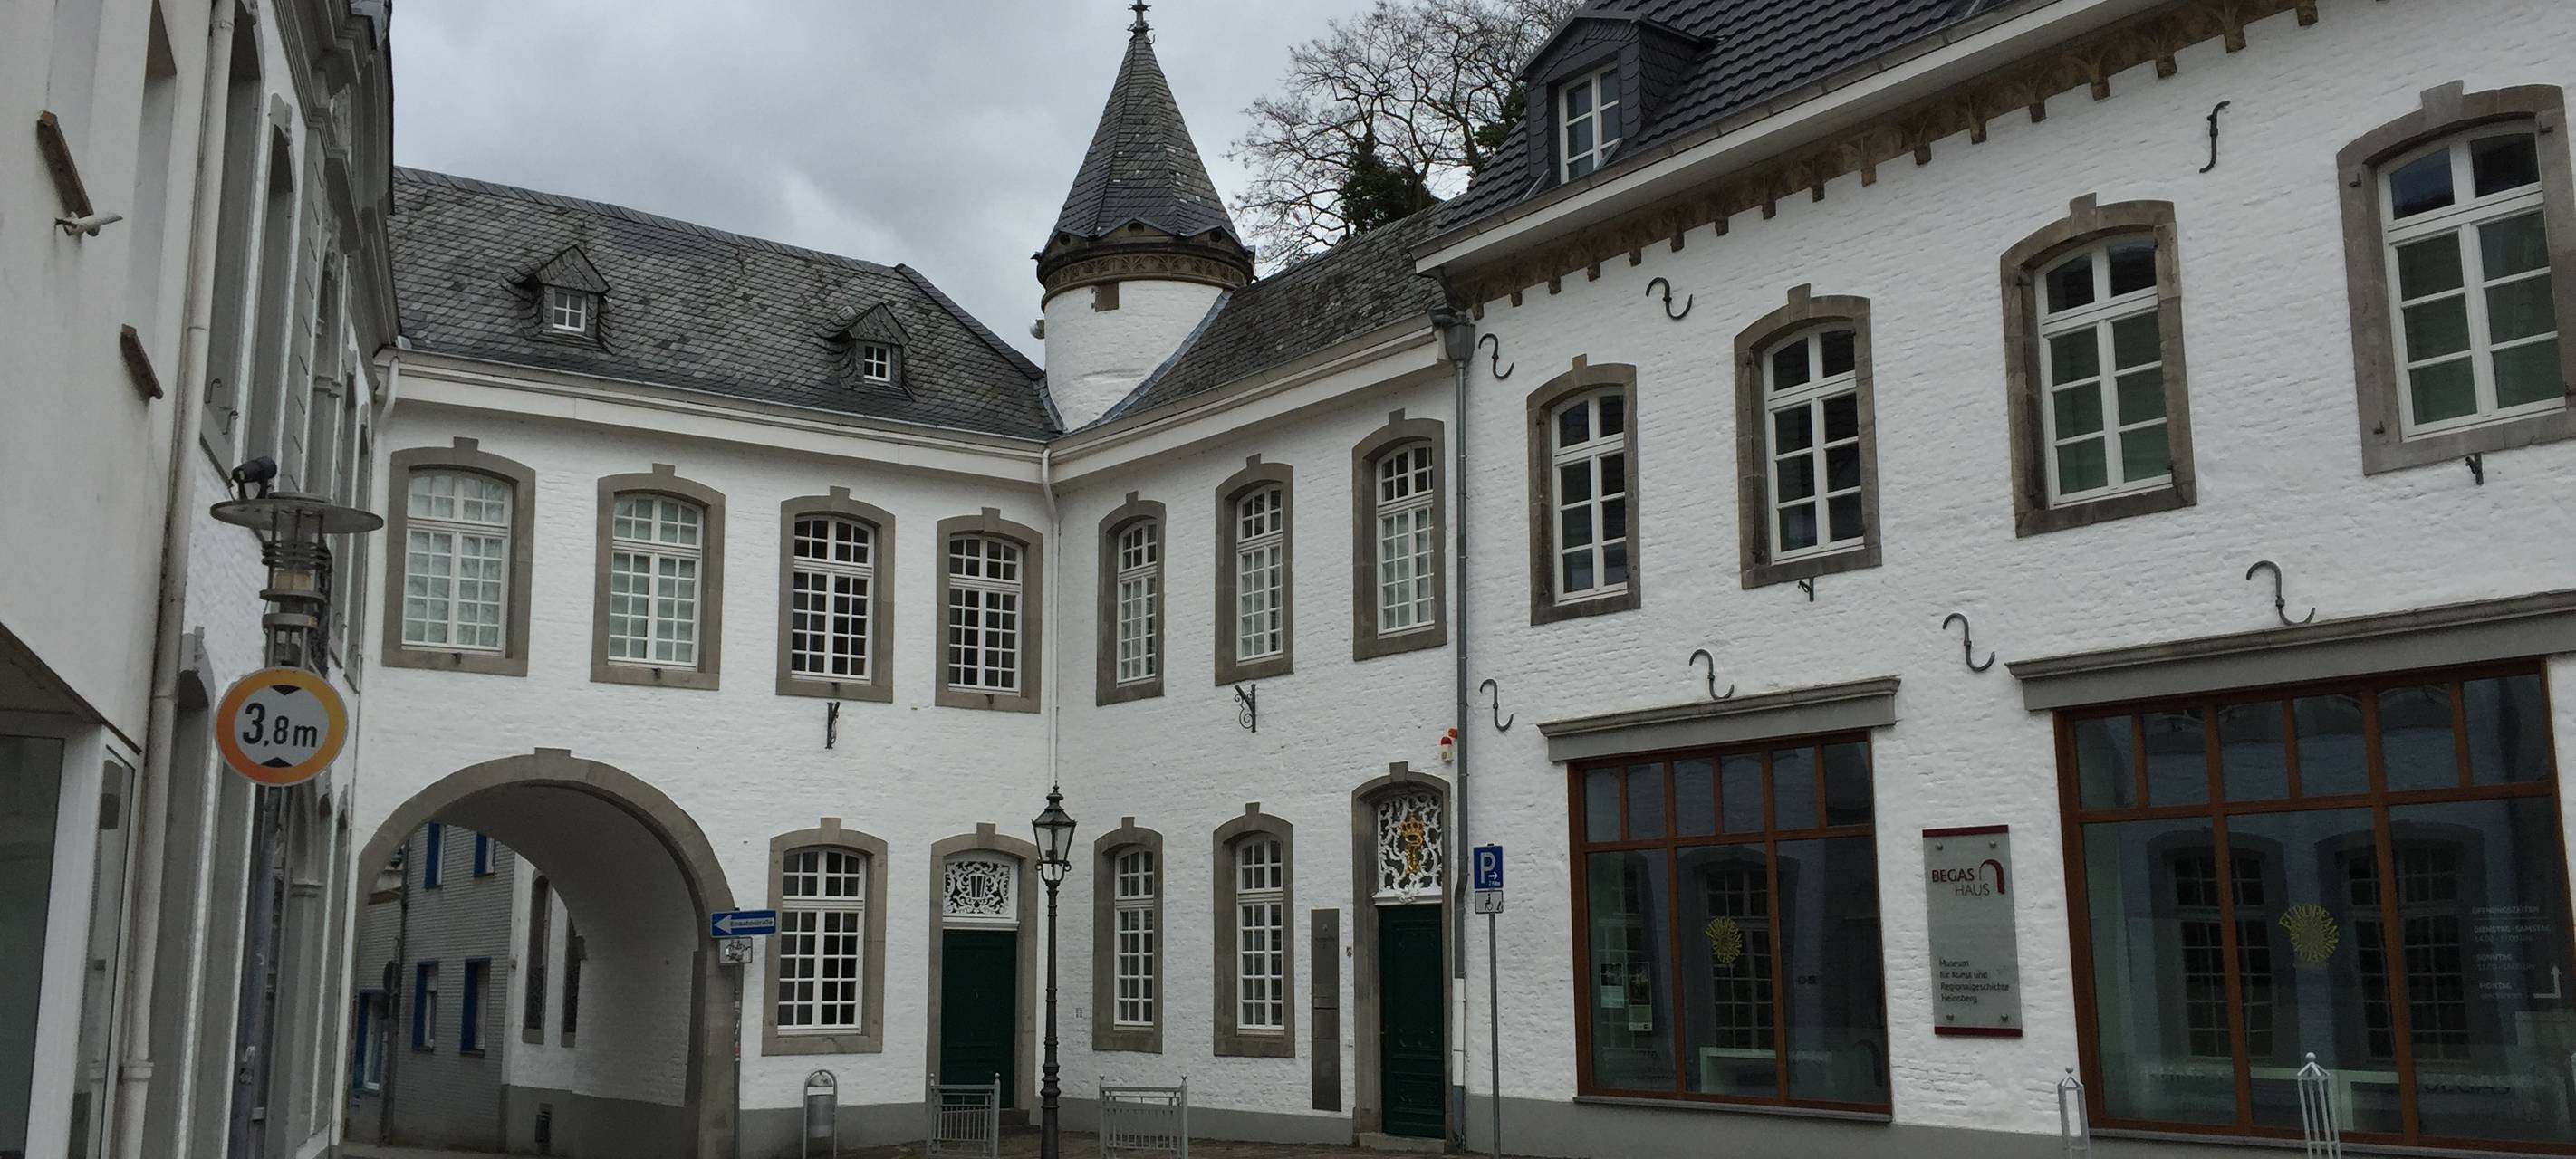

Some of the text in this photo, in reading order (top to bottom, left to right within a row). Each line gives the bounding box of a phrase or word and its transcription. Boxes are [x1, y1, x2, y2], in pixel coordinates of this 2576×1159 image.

[1480, 851, 1496, 884] P
[1931, 867, 1975, 884] BEGAS
[1954, 883, 1991, 896] HAUS
[1938, 958, 1969, 967] Museum
[1951, 970, 1972, 979] Kunst
[1973, 970, 1988, 979] und
